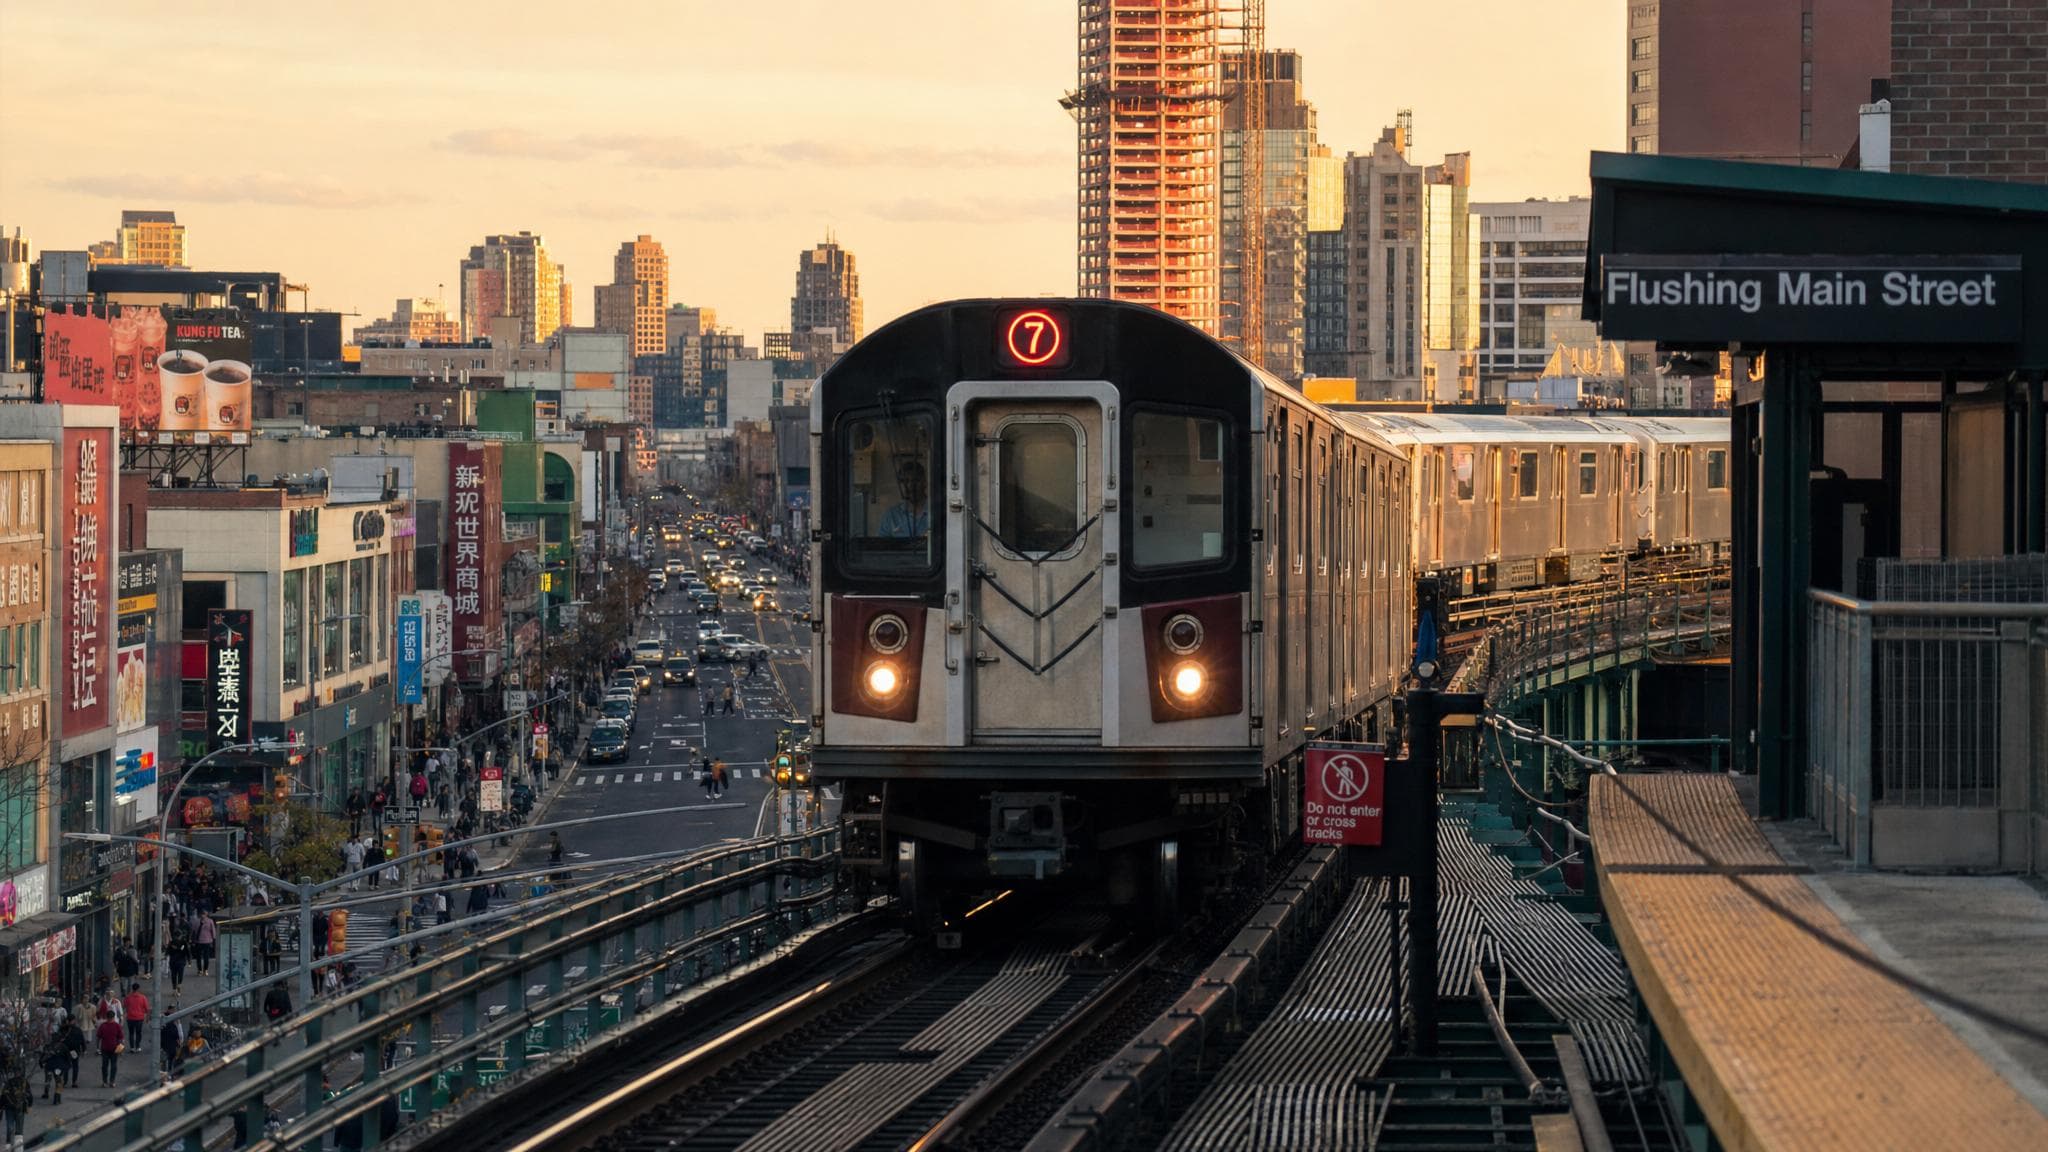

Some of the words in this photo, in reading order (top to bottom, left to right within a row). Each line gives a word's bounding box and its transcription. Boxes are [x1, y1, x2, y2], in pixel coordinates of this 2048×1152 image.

[1608, 271, 1762, 312] Flushing
[1778, 271, 1867, 306] Main
[1882, 271, 1996, 307] Street
[176, 325, 206, 338] KUNG
[207, 325, 220, 338] FU
[1025, 321, 1044, 355] 7
[1306, 801, 1324, 814] Do
[1327, 803, 1346, 815] not
[1350, 805, 1381, 817] enter
[1306, 816, 1319, 826] or
[1323, 817, 1356, 828] cross
[1306, 826, 1343, 840] tracks
